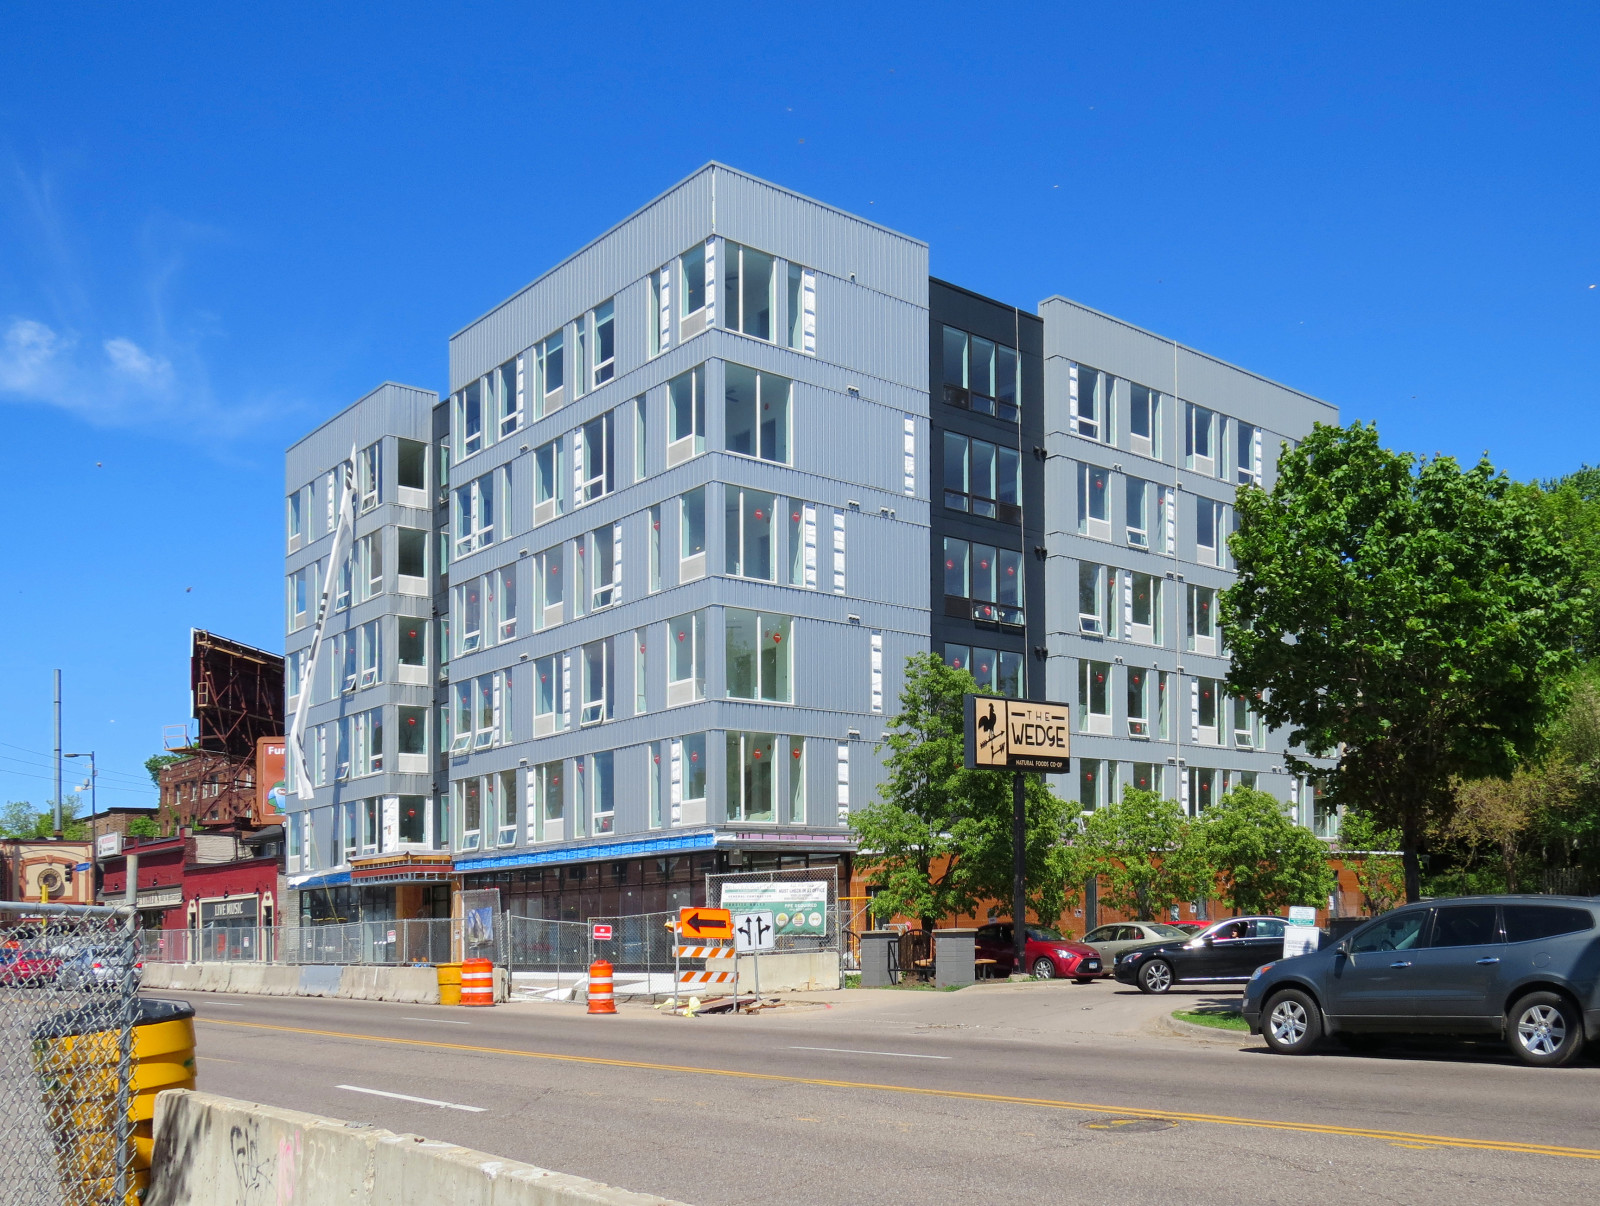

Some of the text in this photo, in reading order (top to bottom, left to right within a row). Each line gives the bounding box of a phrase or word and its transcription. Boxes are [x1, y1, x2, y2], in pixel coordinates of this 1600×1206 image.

[1026, 710, 1050, 722] THE
[1012, 722, 1065, 748] WEDGE
[214, 902, 243, 916] LIVE MUSIC
